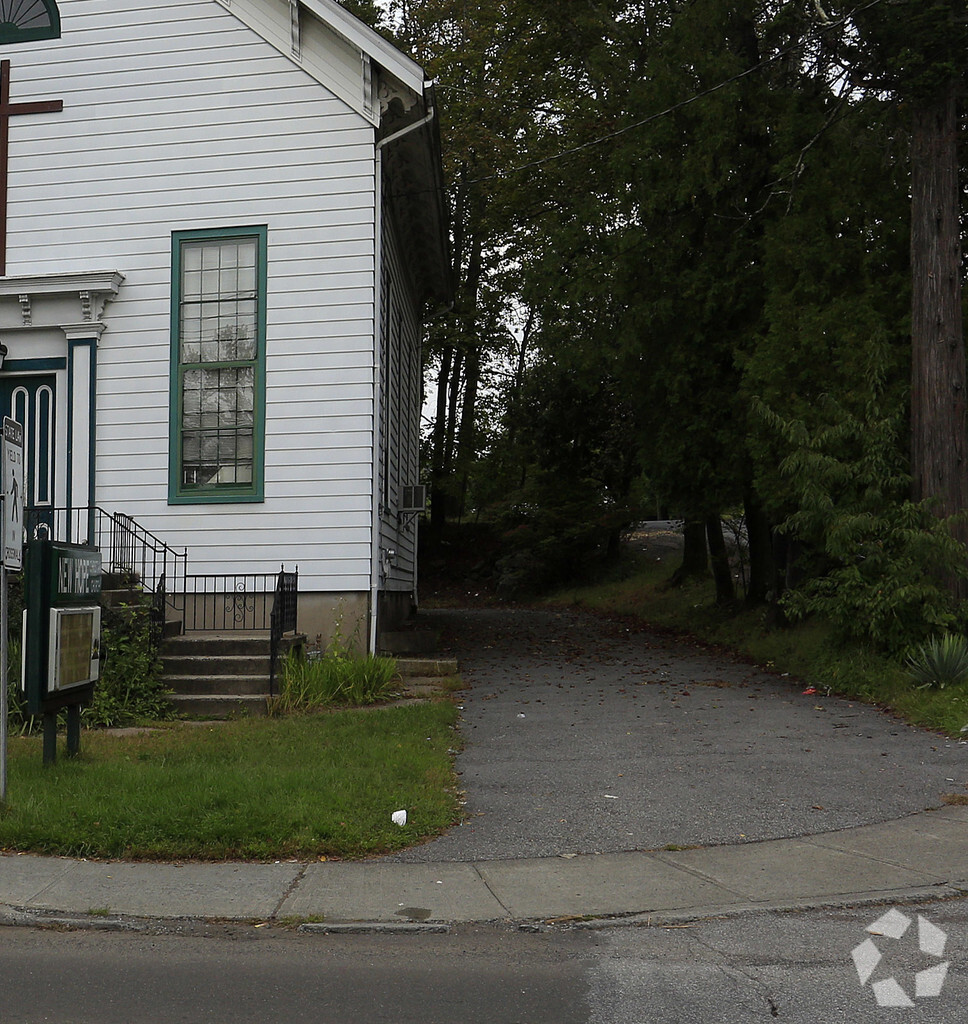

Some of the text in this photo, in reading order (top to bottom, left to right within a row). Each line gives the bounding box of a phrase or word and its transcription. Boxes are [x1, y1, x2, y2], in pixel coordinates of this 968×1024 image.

[8, 450, 16, 462] YIELD
[58, 557, 72, 593] NEW
[74, 558, 89, 593] HOPE
